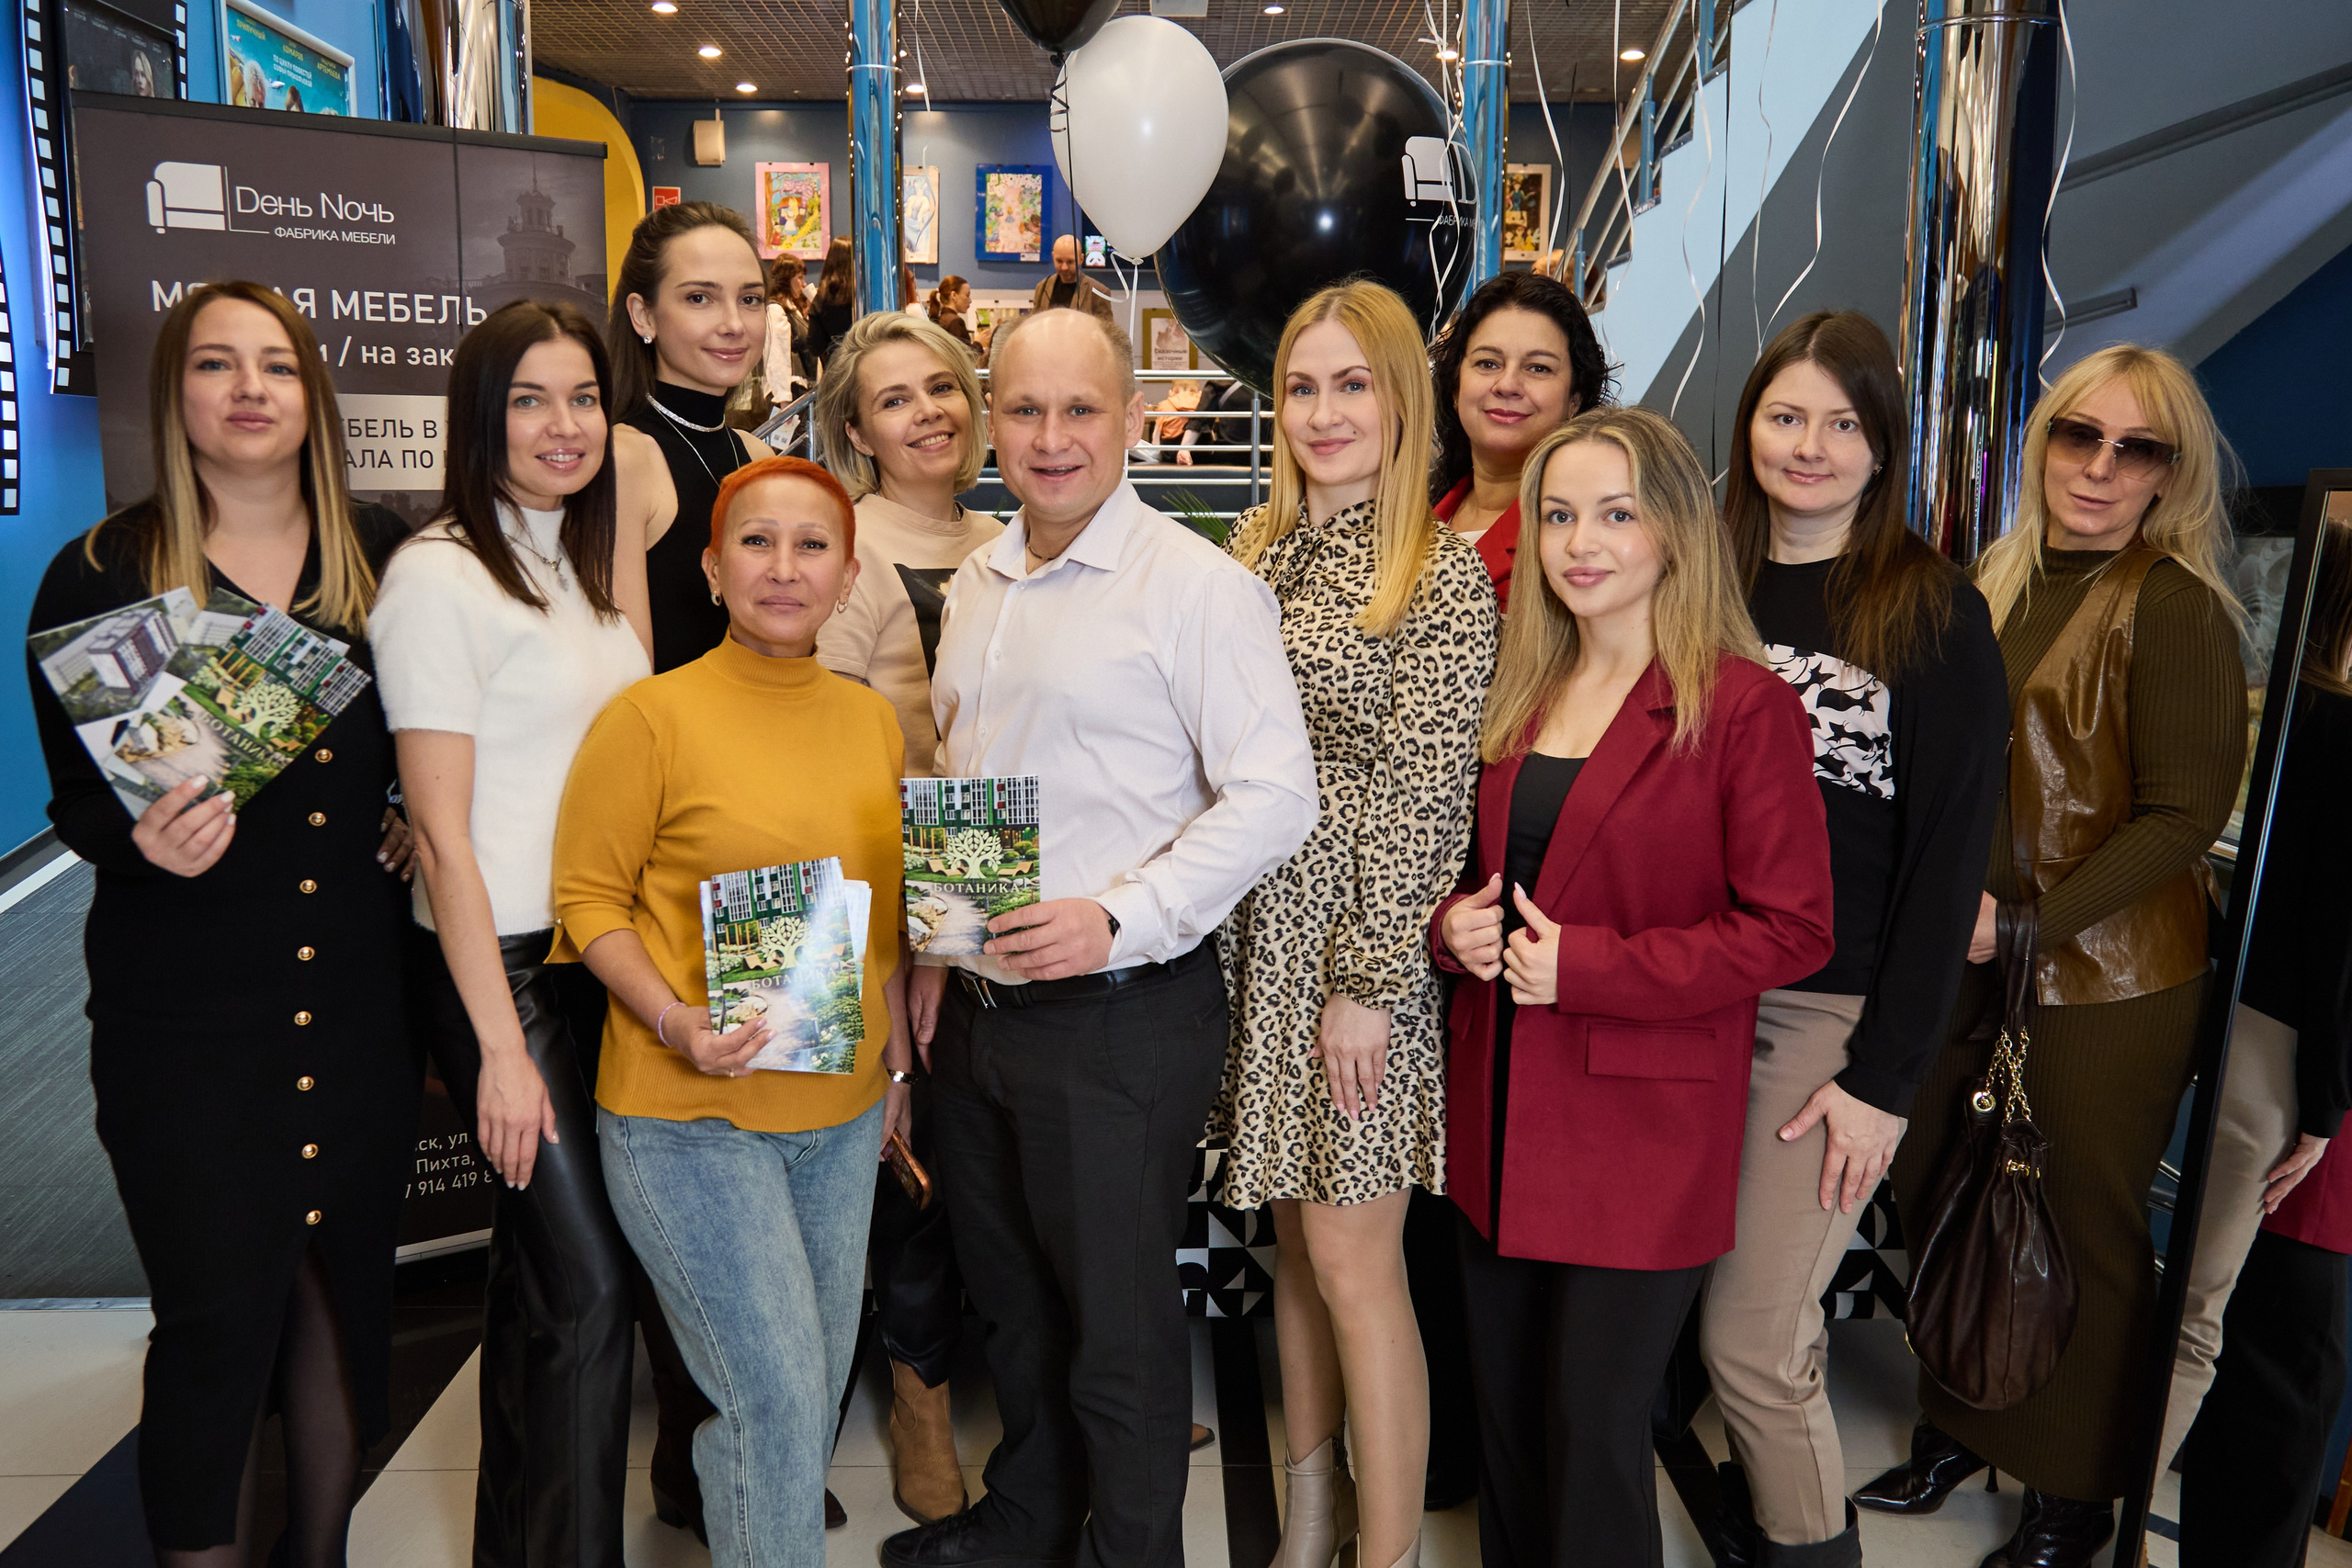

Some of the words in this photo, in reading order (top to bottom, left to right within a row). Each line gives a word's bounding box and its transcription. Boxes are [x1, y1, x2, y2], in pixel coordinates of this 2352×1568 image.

[274, 226, 340, 242] ФАБРИКА
[341, 231, 396, 245] МЕБЕЛИ
[331, 288, 489, 326] МЕБЕЛЬ
[361, 344, 397, 366] на
[406, 346, 456, 367] зак
[343, 418, 414, 439] БЕЛЬ
[423, 419, 438, 439] В
[401, 450, 435, 469] ПО
[933, 882, 1021, 894] БОТАНИКА
[752, 966, 837, 989] БОТАНИКА
[416, 1154, 475, 1174] Пихта,
[418, 1177, 446, 1196] 914
[451, 1171, 478, 1189] 419
